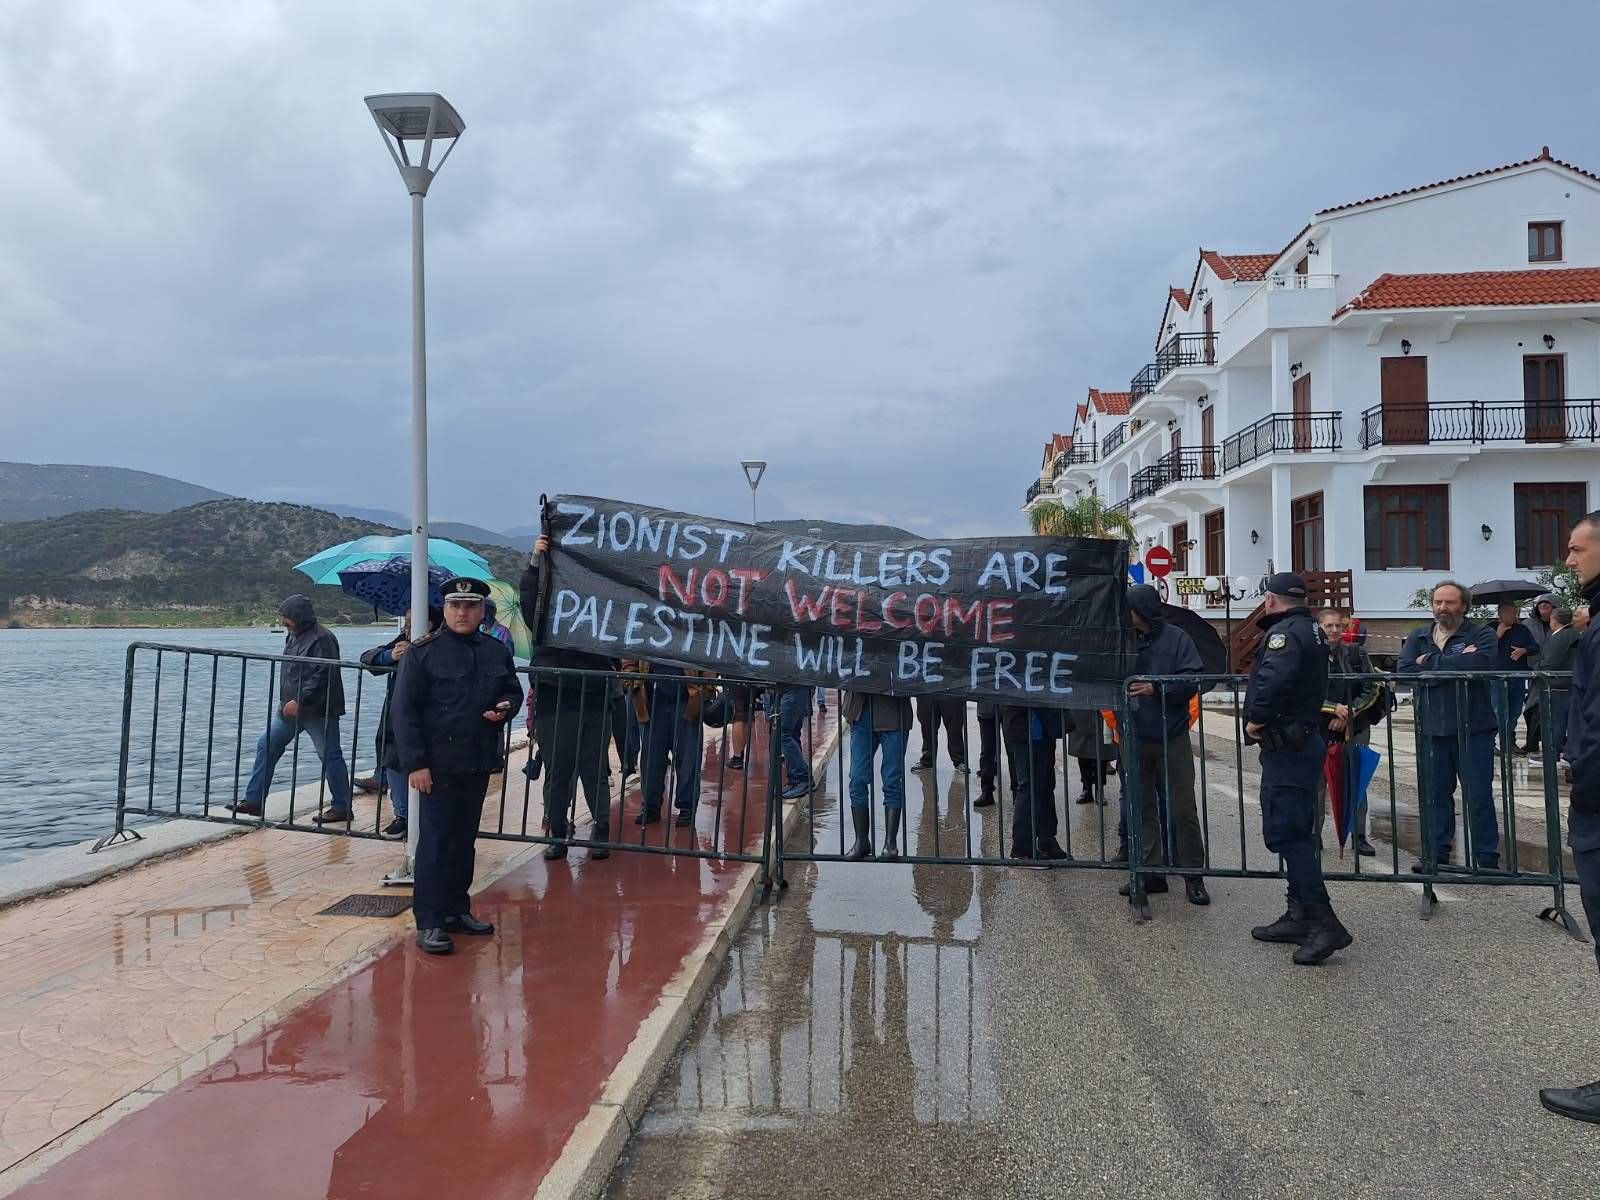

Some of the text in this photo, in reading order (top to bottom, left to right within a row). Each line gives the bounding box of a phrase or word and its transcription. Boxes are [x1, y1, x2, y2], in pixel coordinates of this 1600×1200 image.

[556, 503, 1068, 596] ZIONIST KILLERS ARE
[552, 589, 1079, 694] PALESTINE WILL BE FREE
[657, 563, 1015, 643] NOT WELCOME
